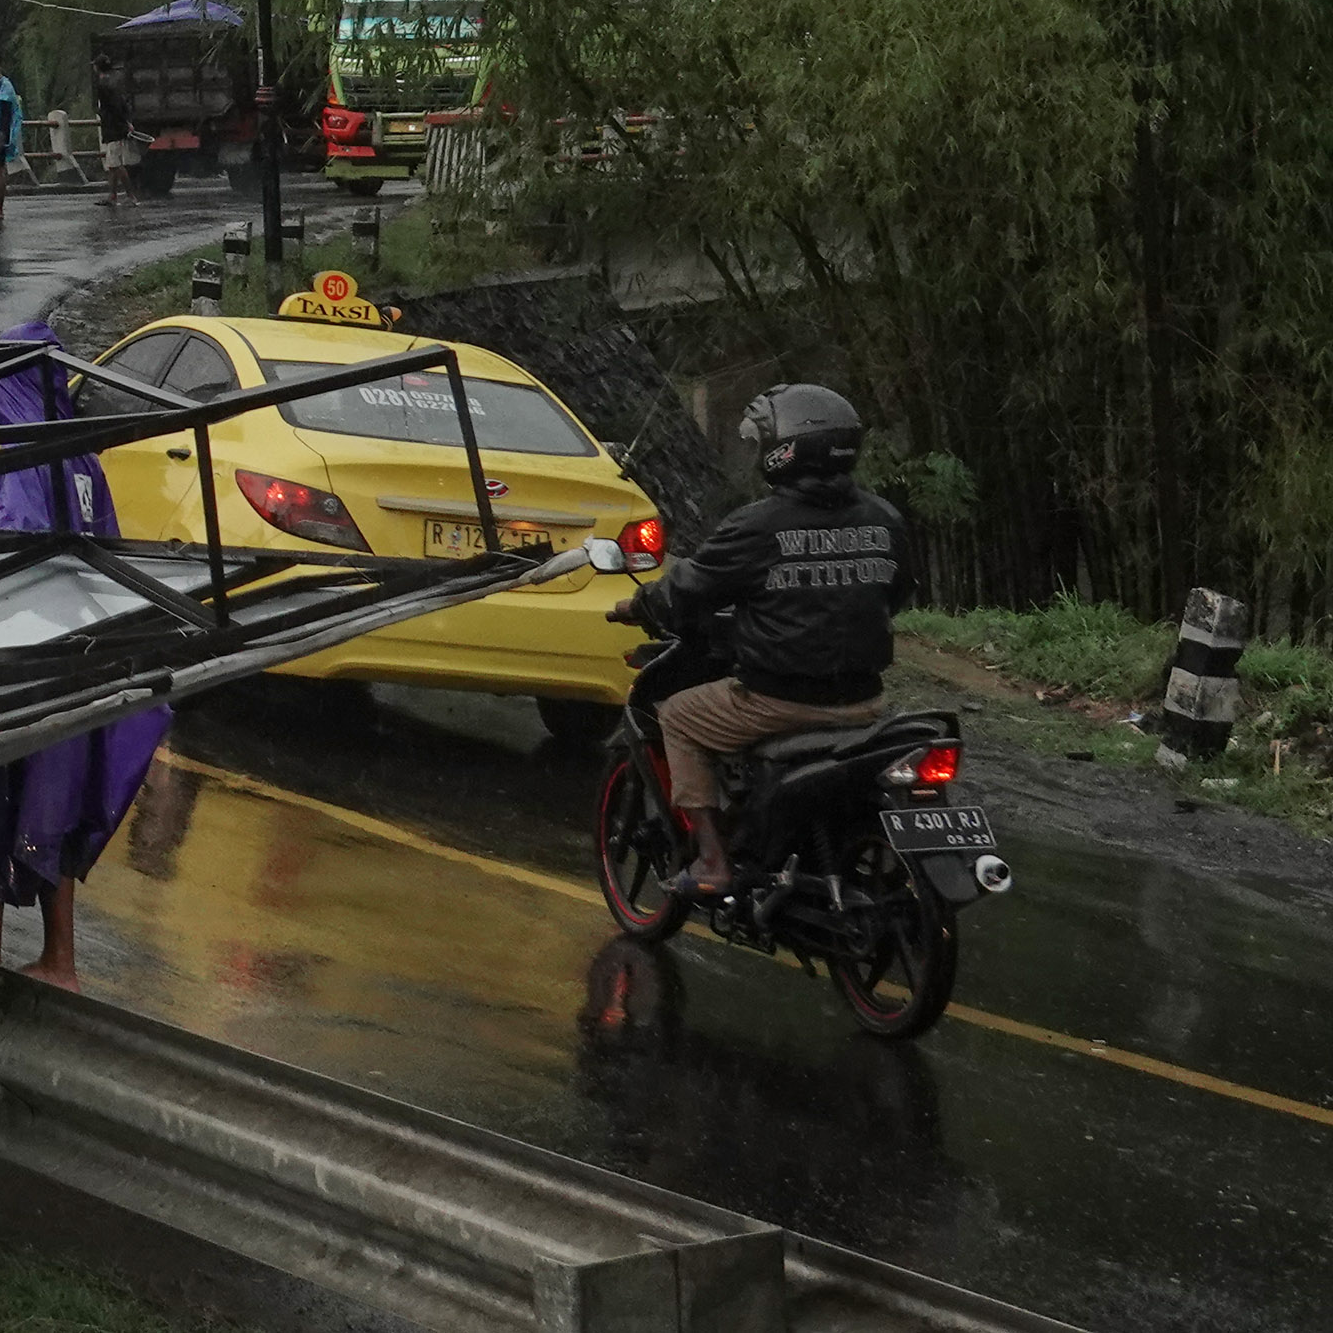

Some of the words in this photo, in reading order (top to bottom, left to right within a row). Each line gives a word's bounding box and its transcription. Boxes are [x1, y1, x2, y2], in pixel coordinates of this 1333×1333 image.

[328, 279, 345, 297] 50
[297, 297, 372, 321] TAKSI
[359, 387, 413, 406] 0281
[433, 523, 443, 545] R
[776, 526, 891, 556] WINGED
[890, 815, 904, 831] R
[958, 811, 981, 828] RJ
